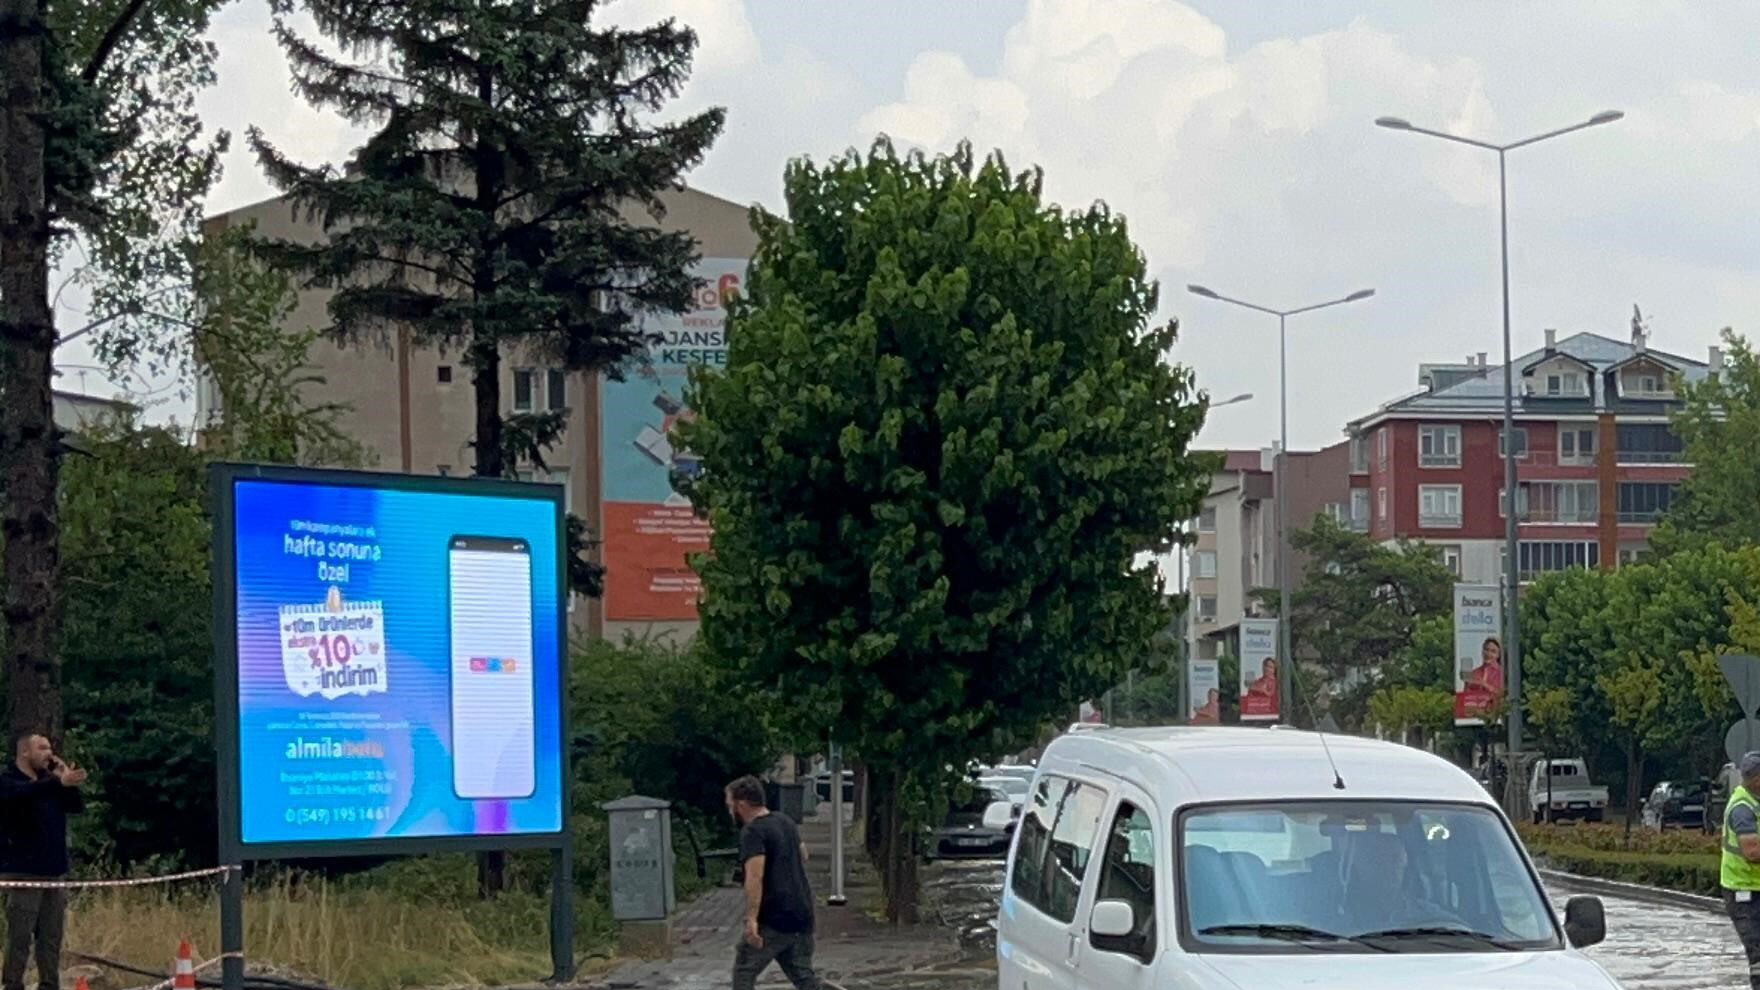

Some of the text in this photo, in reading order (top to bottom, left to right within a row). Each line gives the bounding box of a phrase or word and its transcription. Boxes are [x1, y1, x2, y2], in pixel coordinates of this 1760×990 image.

[284, 533, 382, 561] hafta sonuna
[318, 561, 350, 583] özel
[321, 664, 378, 689] indirim
